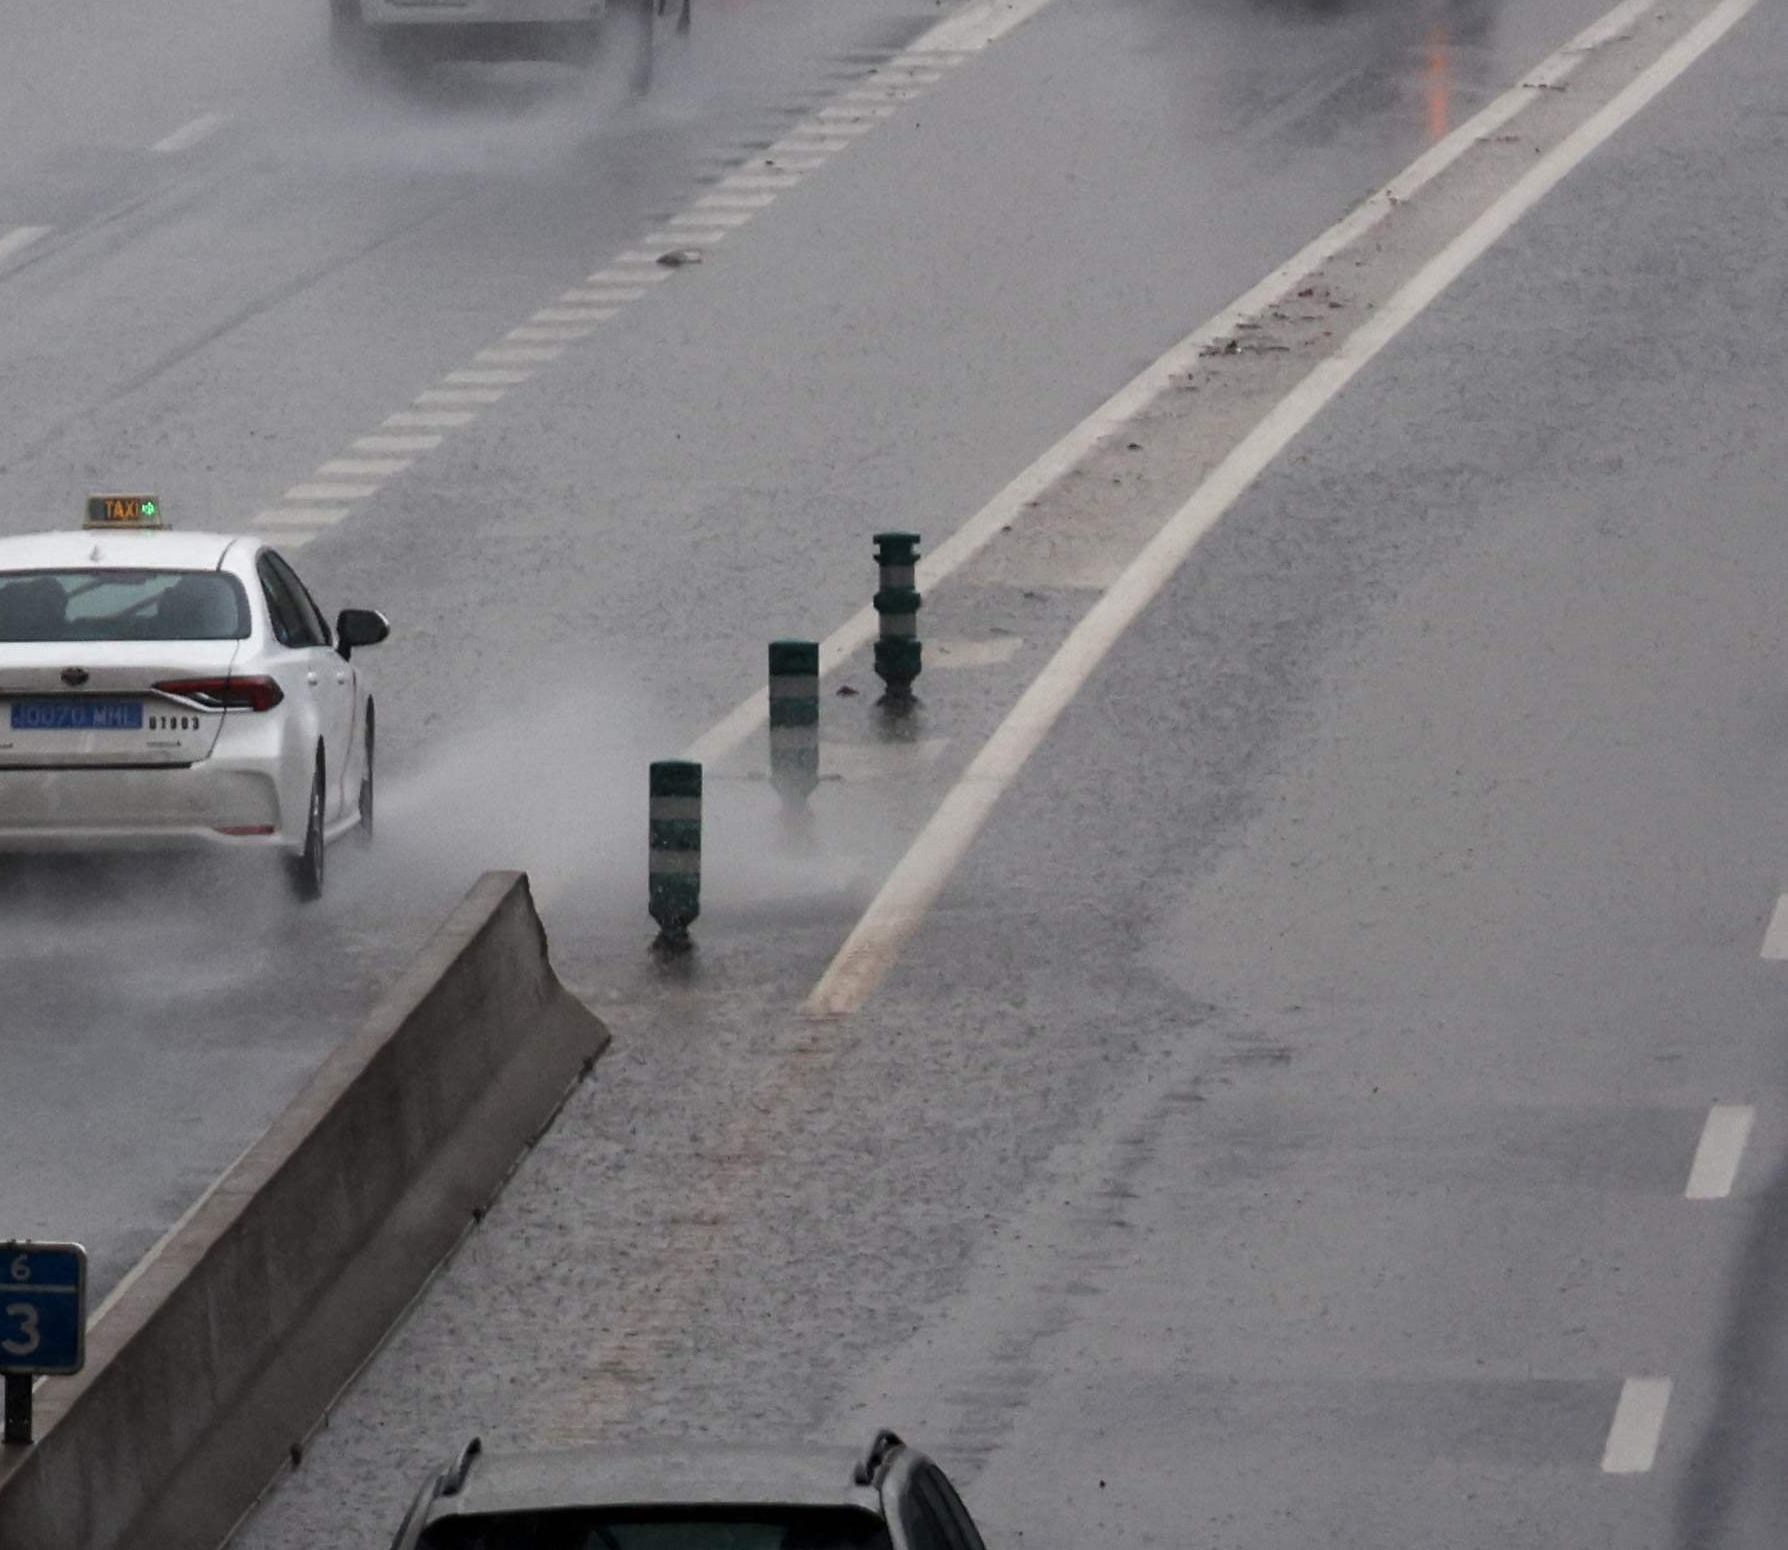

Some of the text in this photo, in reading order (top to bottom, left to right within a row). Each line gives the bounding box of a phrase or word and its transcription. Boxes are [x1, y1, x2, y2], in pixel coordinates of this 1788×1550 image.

[105, 497, 138, 521] TAXI
[10, 1253, 32, 1281] 6
[1, 1301, 41, 1356] 3
